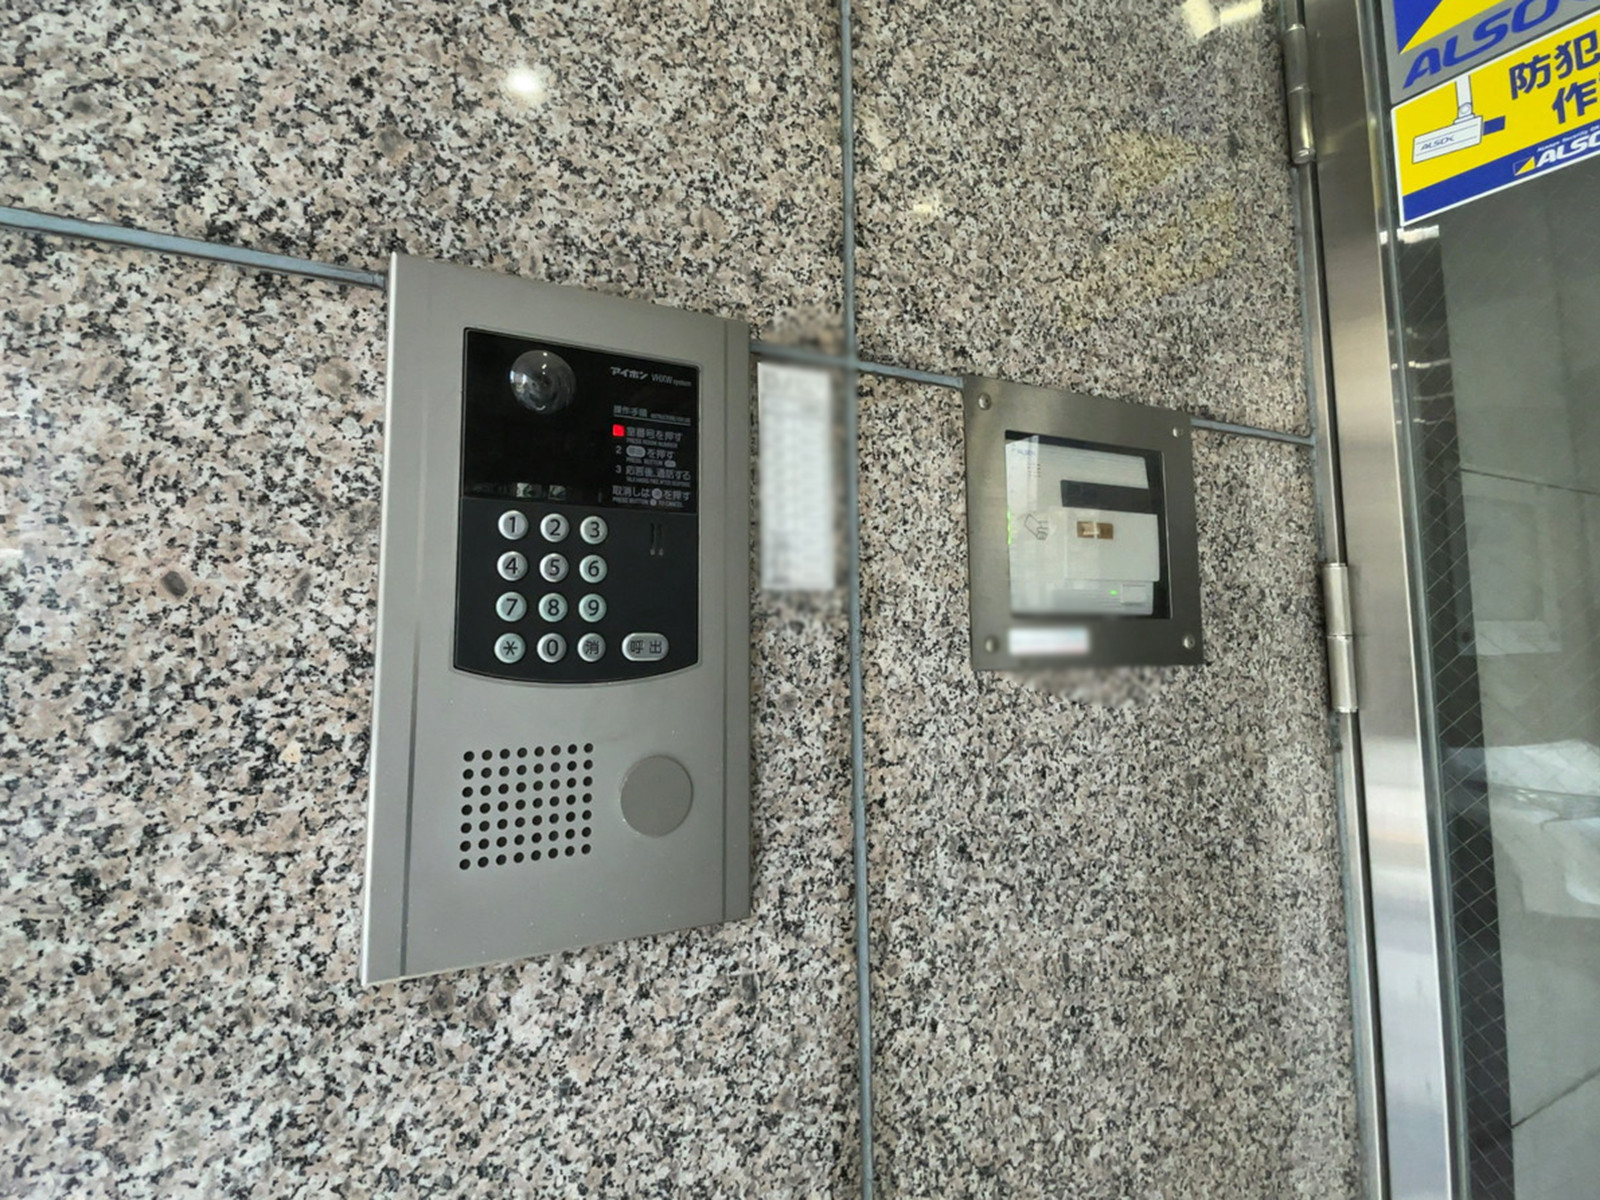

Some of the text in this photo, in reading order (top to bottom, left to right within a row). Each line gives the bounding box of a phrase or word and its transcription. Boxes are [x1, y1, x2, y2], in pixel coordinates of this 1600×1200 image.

[1403, 0, 1587, 89] ALSO
[1509, 29, 1600, 100] 防犯
[610, 366, 648, 380] アイホン
[616, 445, 622, 455] 2
[615, 464, 622, 474] 3
[550, 518, 561, 536] 2
[590, 521, 600, 538] 3
[505, 557, 518, 574] 4
[549, 559, 560, 576] 5
[588, 560, 599, 577] 6
[506, 598, 518, 616] 7
[548, 599, 559, 616] 8
[588, 600, 599, 616] 9
[546, 639, 559, 657] 0
[585, 640, 600, 654] 消
[630, 639, 662, 654] 呼出
